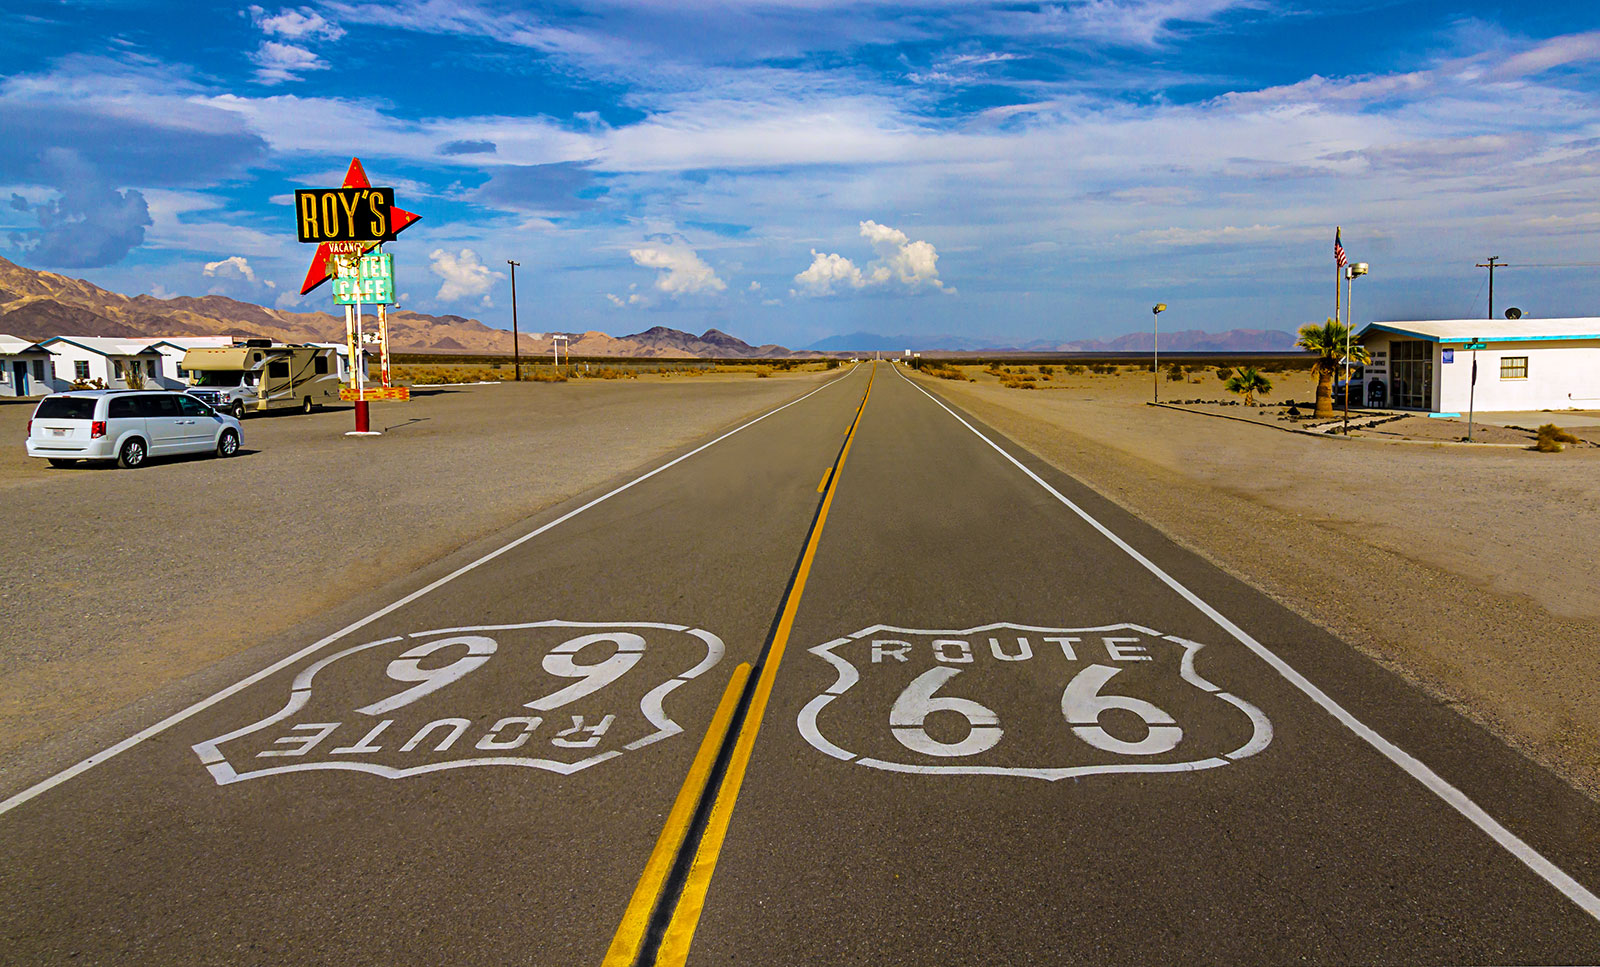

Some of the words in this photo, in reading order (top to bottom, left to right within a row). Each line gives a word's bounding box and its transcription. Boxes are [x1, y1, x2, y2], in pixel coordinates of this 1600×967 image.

[301, 190, 386, 238] ROY'S
[340, 280, 386, 301] CAFE
[870, 637, 1153, 663] ROUTE
[353, 632, 647, 715] 66
[889, 664, 1183, 756] 66
[256, 715, 616, 757] ROUTE
